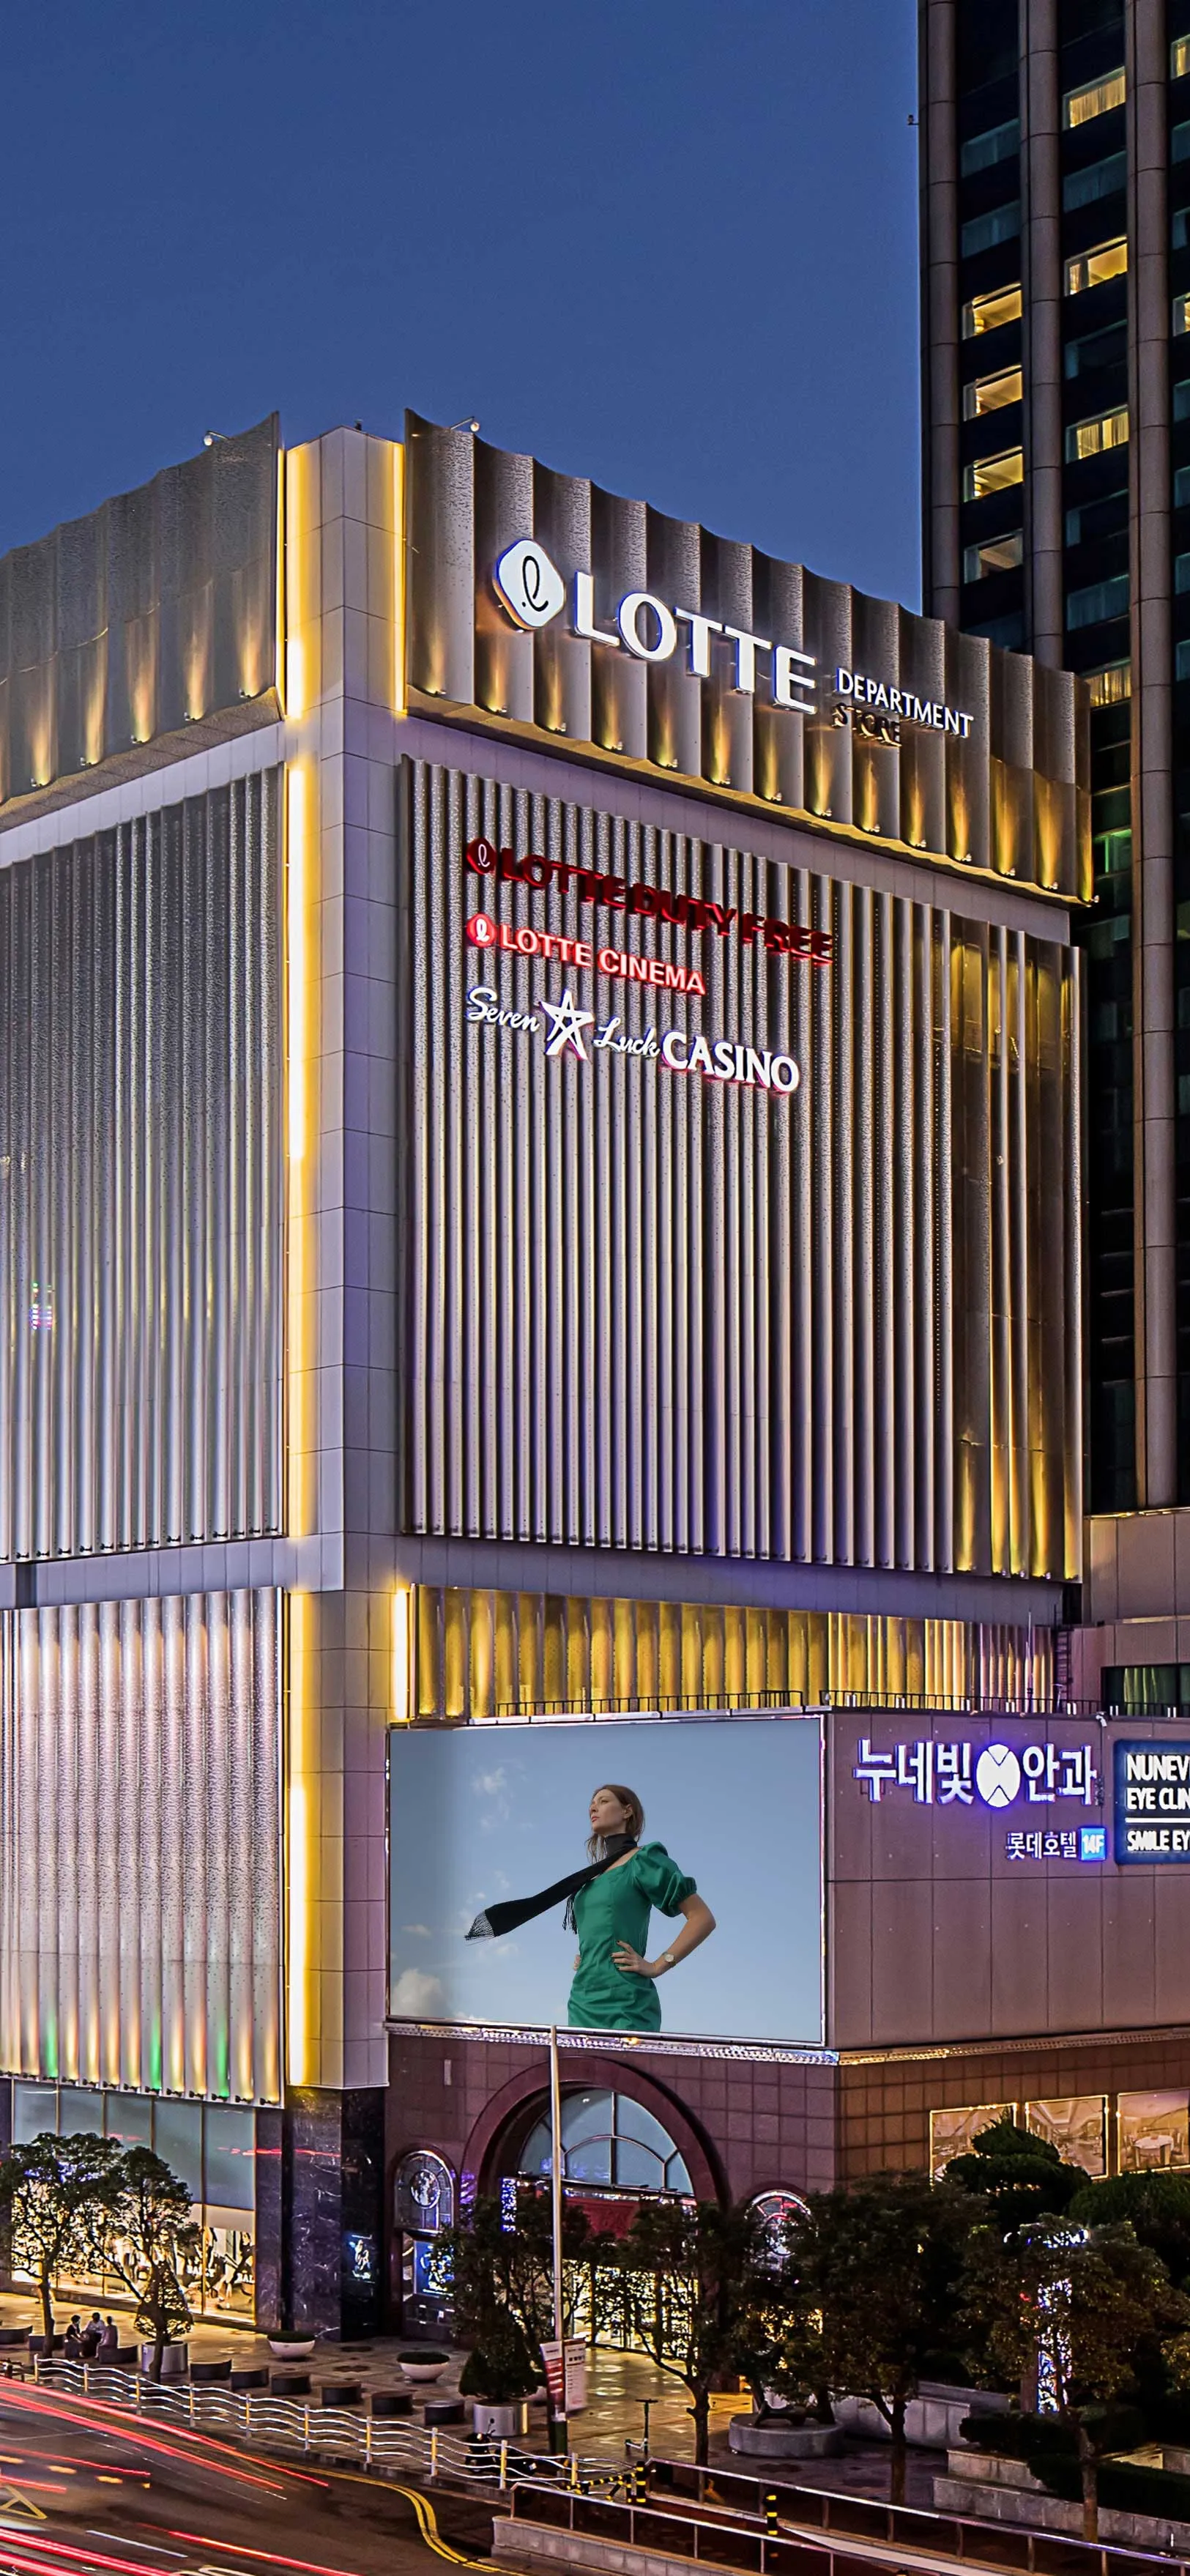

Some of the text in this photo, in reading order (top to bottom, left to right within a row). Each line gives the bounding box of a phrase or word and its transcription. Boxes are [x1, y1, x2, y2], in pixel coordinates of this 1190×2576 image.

[574, 571, 817, 714] LOTTE
[832, 702, 902, 747] STORE
[836, 667, 975, 739] DEPARTMENT
[502, 848, 833, 964] LOTTE DUTY FREE
[499, 924, 705, 995] LOTTE CINEMA
[466, 987, 800, 1095] Seven Luck CASINO
[853, 1737, 1098, 1805] 누네빛 안과
[1126, 1753, 1190, 1781] NUNEV
[1127, 1787, 1156, 1810] EYE
[1005, 1831, 1105, 1860] 롯데호텔 14F
[1127, 1830, 1169, 1852] SMILE
